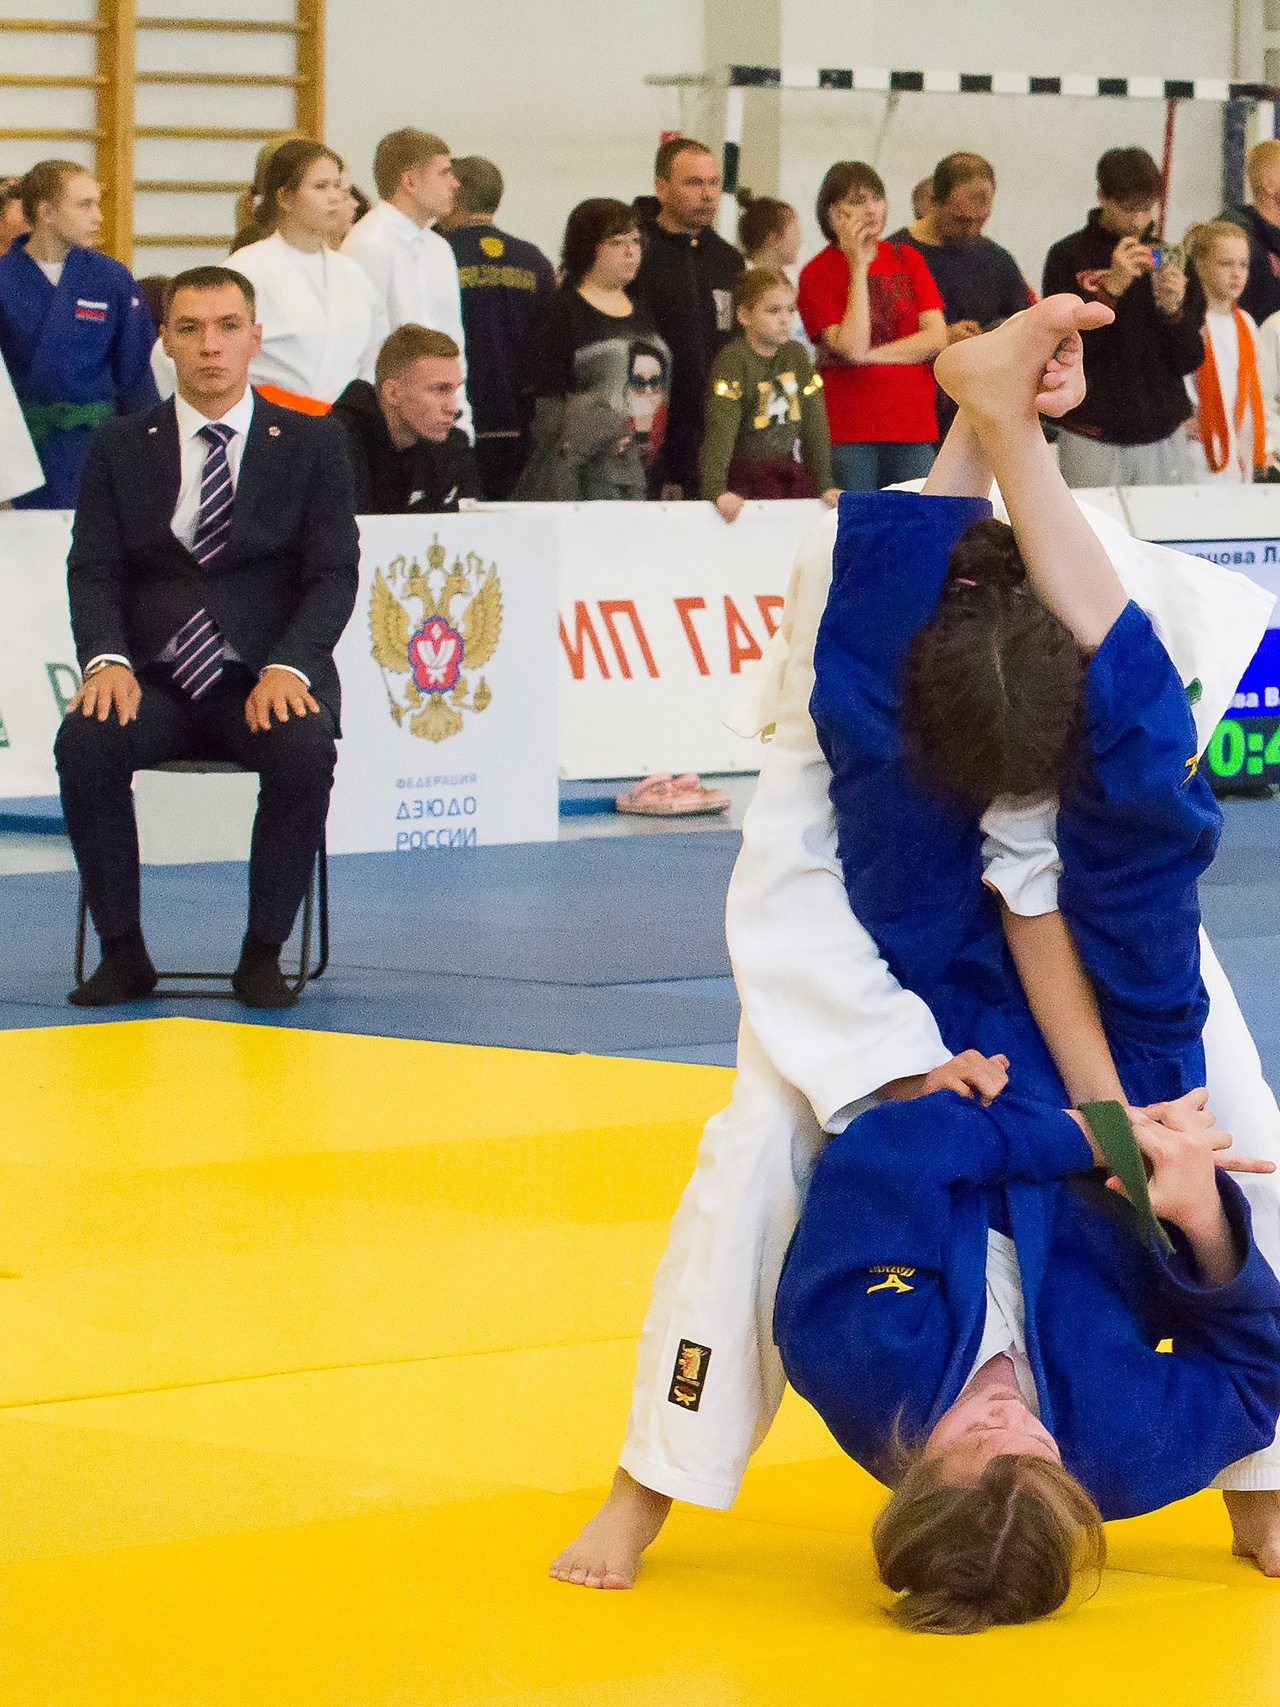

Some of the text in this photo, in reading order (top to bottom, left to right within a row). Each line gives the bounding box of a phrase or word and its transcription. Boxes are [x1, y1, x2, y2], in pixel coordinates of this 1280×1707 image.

[558, 599, 661, 680] ИП
[396, 772, 477, 789] ФЕДЕРАЦИЯ
[396, 796, 477, 820] ДЗЮДО
[396, 827, 477, 851] РОССИИ
